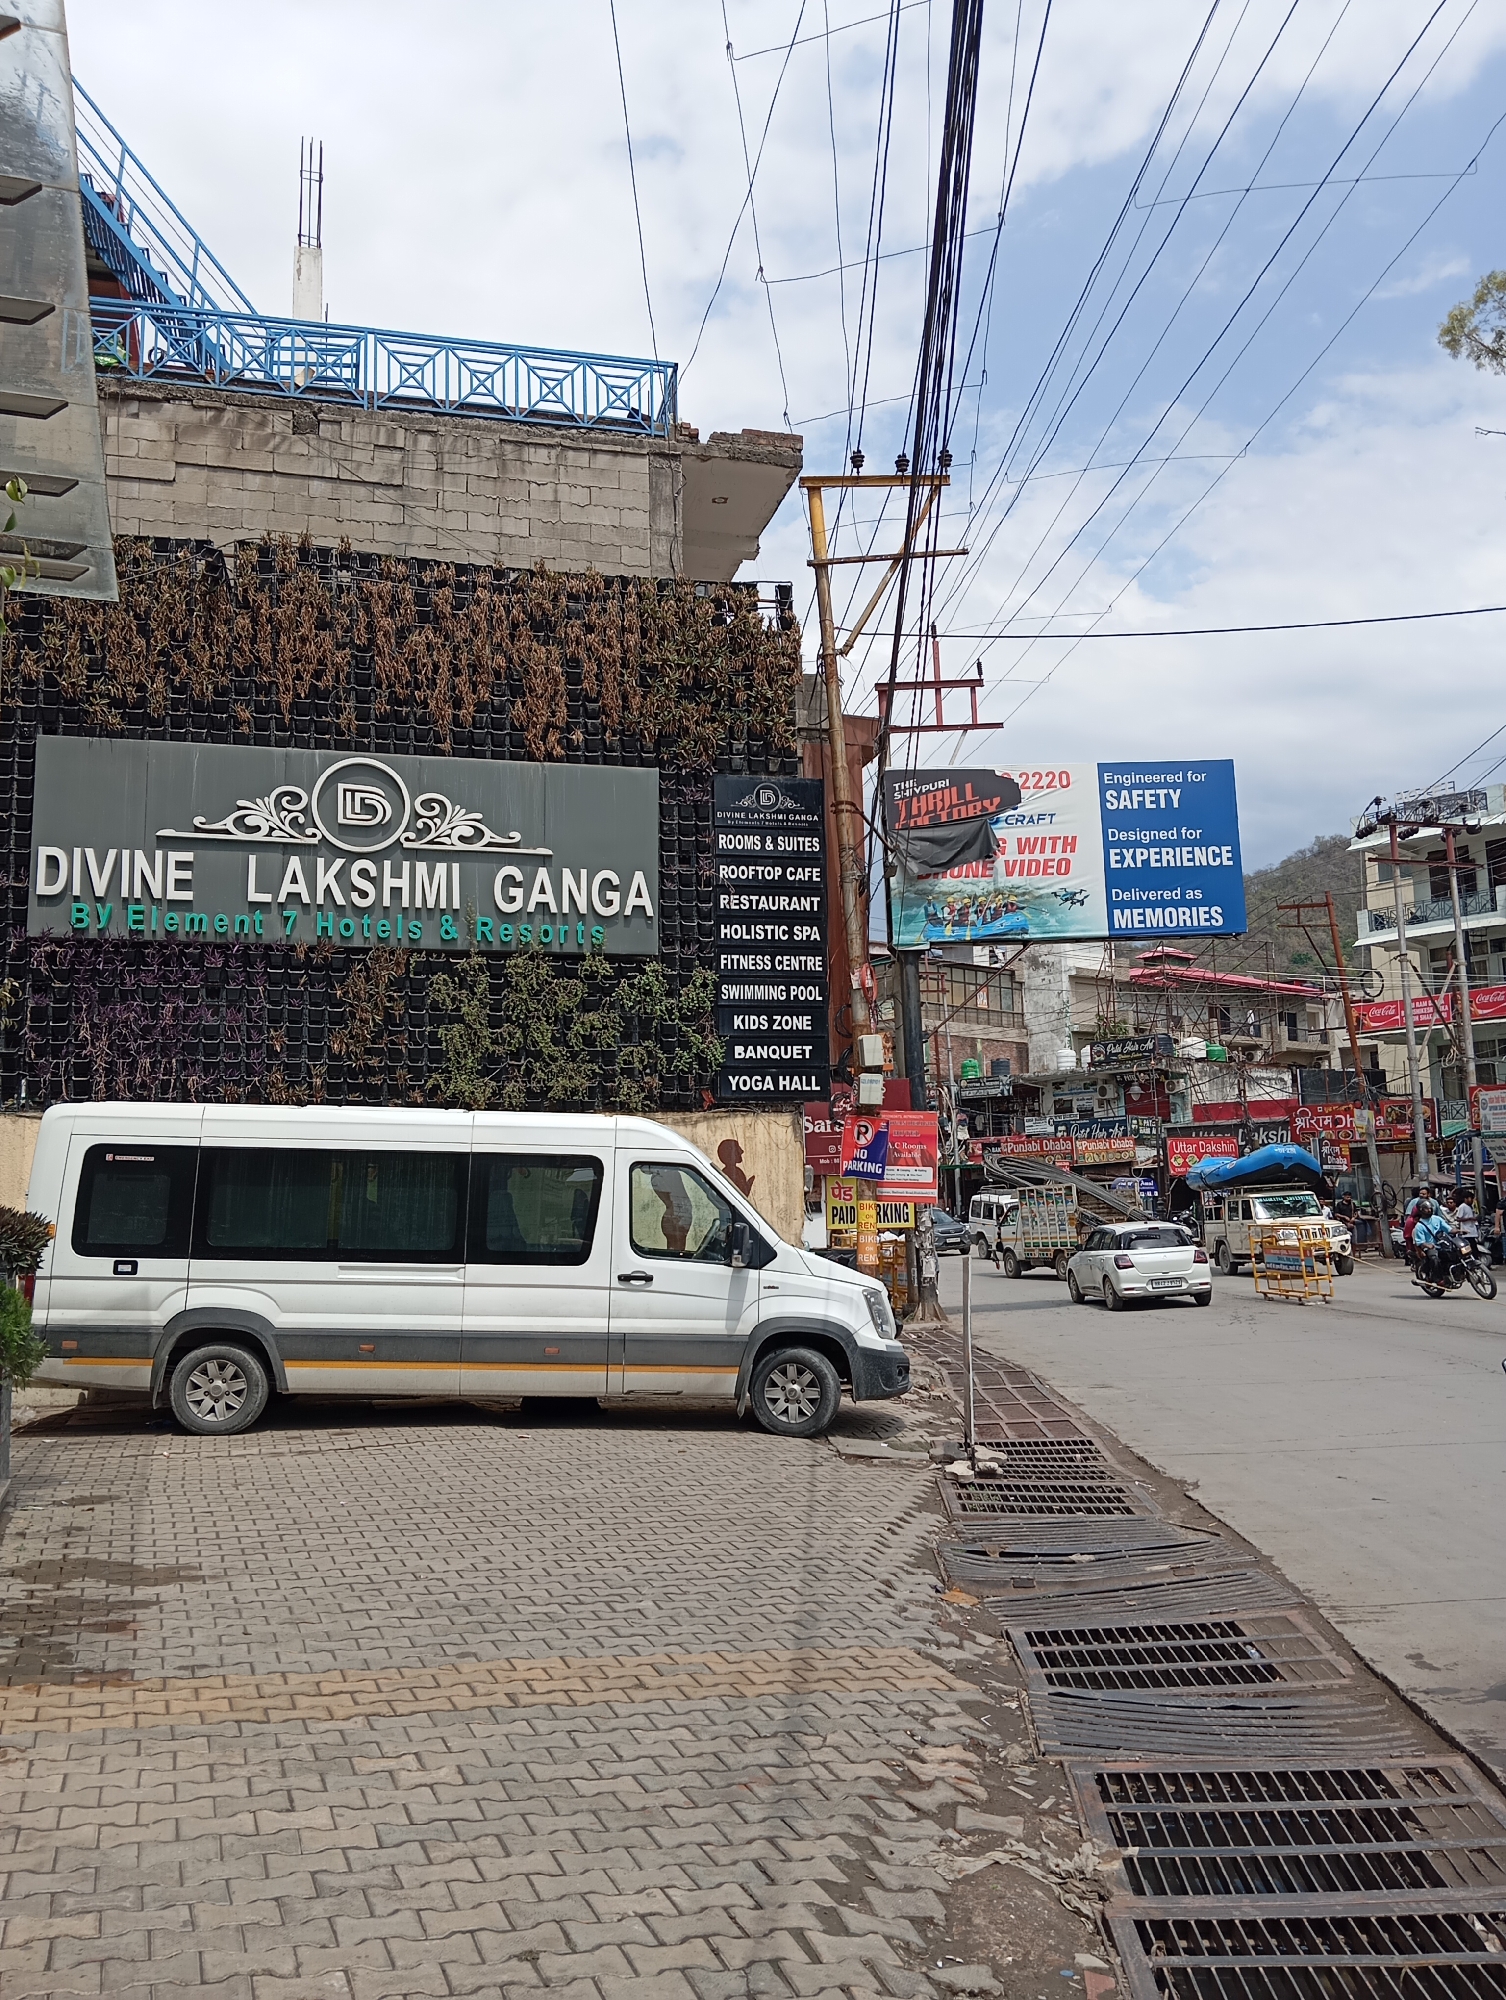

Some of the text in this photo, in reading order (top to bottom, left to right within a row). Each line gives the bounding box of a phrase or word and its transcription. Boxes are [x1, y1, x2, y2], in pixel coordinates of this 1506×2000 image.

[893, 778, 917, 791] THE
[1018, 770, 1072, 790] 2220
[1103, 771, 1207, 786] Engineered for
[893, 779, 950, 800] SHIVPURI
[893, 782, 980, 824] THRILL
[1105, 788, 1181, 810] SAFETY
[789, 814, 819, 822] GANGA
[1004, 812, 1057, 826] CRAFT
[719, 834, 820, 851] ROOMS & SUITES
[1108, 827, 1202, 843] Designed for
[1016, 835, 1078, 855] WITH
[1109, 846, 1234, 868] EXPERIENCE
[720, 865, 821, 881] ROOFTOP CAFE
[1004, 857, 1071, 877] VIDEO
[35, 845, 654, 917] DIVINE LAKSHMI GANGA
[1111, 887, 1203, 901] Delivered as
[720, 895, 820, 911] RESTAURANT
[71, 902, 605, 944] By Element 7 Hotels & Resorts
[1113, 906, 1224, 929] MEMORIES
[721, 924, 820, 941] HOLISTIC SPA
[720, 954, 822, 971] FITNESS CENTRE
[721, 984, 822, 1000] SWIMMING POOL
[734, 1015, 812, 1030] KIDS ZONE
[734, 1045, 812, 1060] BANQUET
[728, 1075, 820, 1091] YOGA HALL
[902, 1142, 927, 1150] Rooms
[1007, 1139, 1040, 1154] Punjabi
[1043, 1138, 1072, 1151] Dhaba
[1082, 1138, 1133, 1151] Punjabi Dhaba
[1172, 1139, 1235, 1154] Uttar Dakshin
[853, 1148, 868, 1159] NO
[893, 1151, 921, 1159] Available
[1327, 1155, 1347, 1165] Dhaba
[842, 1160, 882, 1174] PARKING
[831, 1181, 854, 1201] पेड
[831, 1205, 856, 1225] PAID
